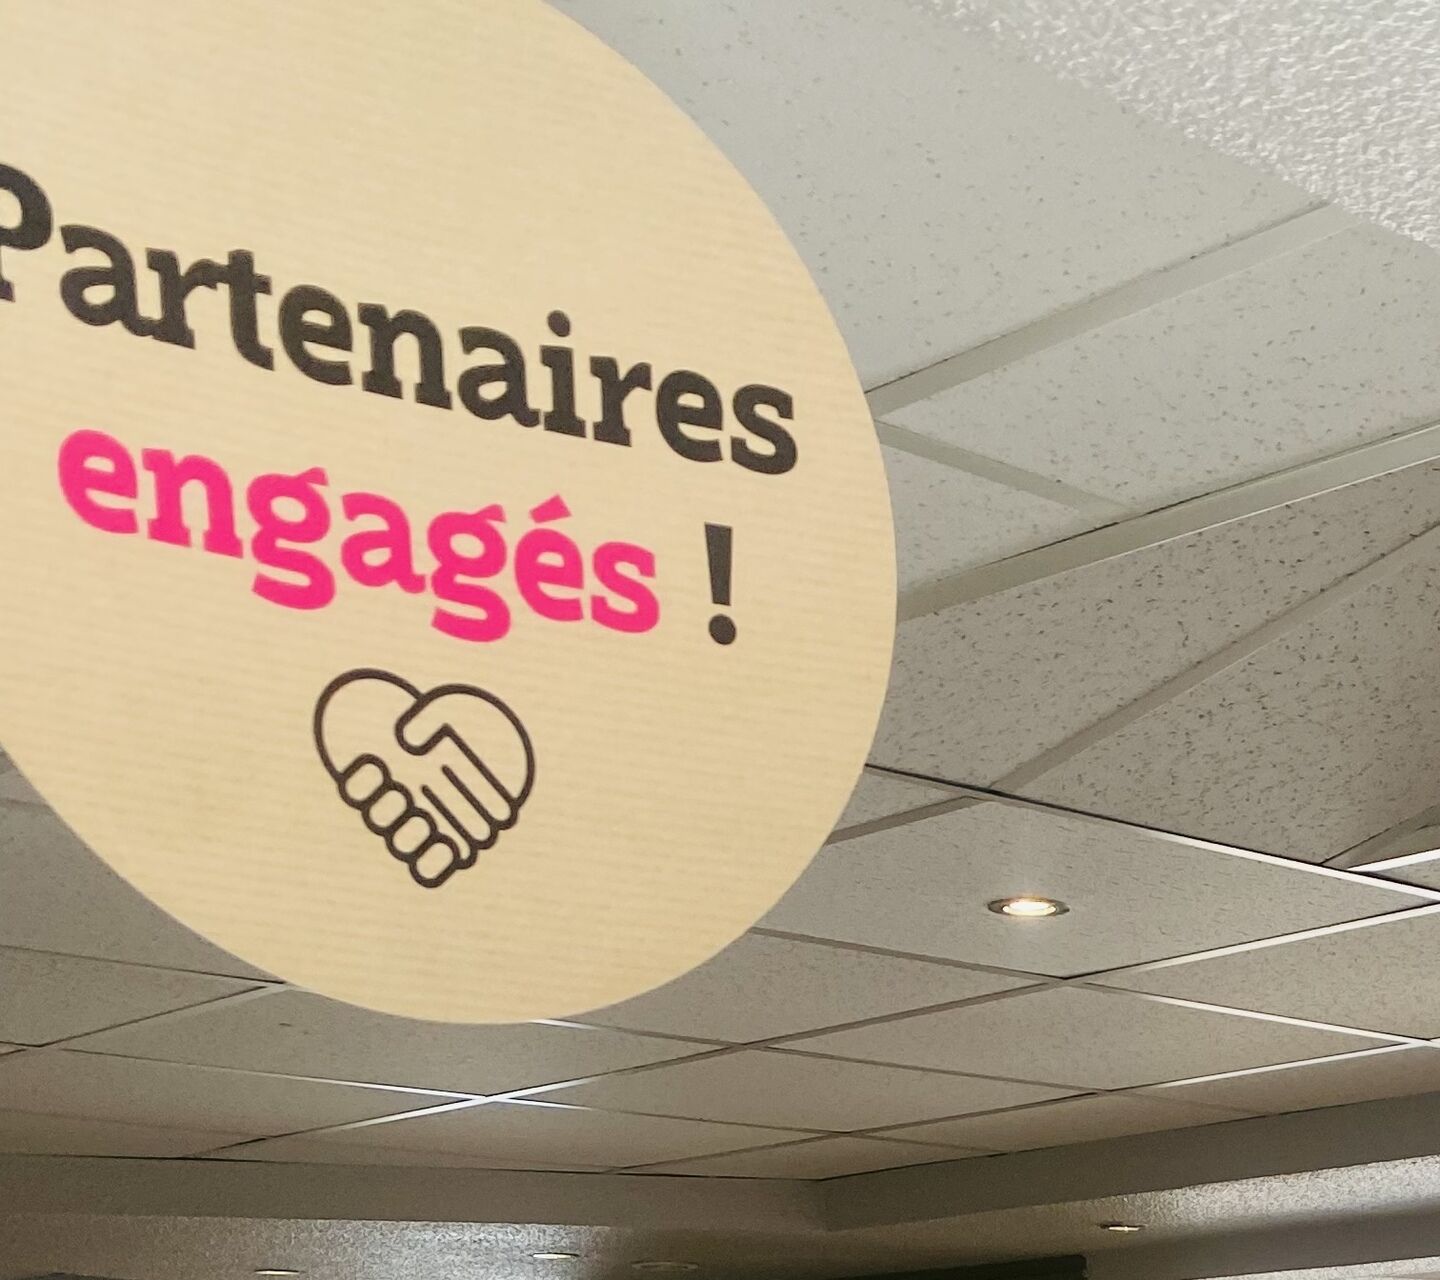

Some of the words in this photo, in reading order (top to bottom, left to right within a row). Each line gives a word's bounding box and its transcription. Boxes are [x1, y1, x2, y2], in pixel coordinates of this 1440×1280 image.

[0, 164, 797, 475] Partenaires
[58, 428, 660, 643] engagés
[704, 523, 738, 646] !
